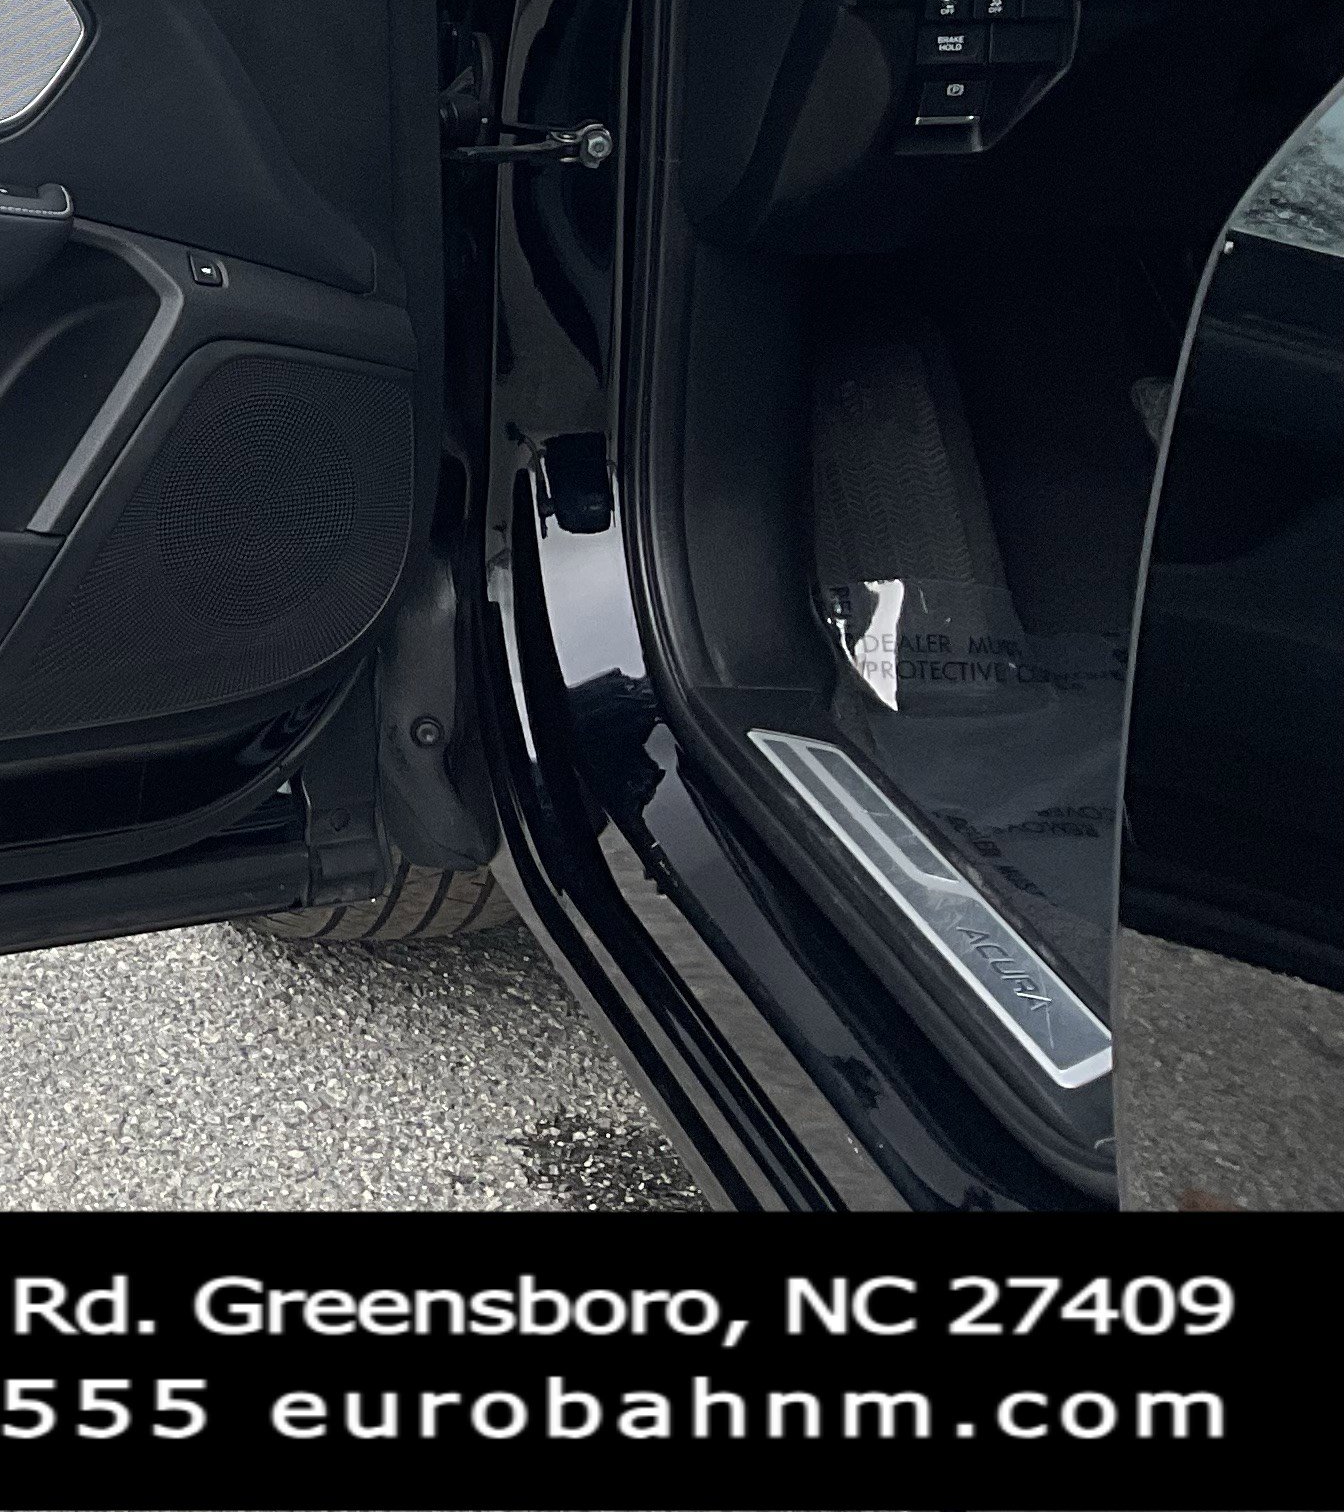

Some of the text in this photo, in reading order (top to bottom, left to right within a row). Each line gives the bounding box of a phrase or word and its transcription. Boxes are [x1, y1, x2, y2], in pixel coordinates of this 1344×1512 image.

[940, 7, 955, 15] OFF
[937, 35, 965, 44] BRAKE
[938, 43, 963, 52] HOLD
[862, 634, 952, 654] DEALER
[864, 660, 1011, 683] PROTECTIVE
[955, 926, 1053, 1010] ACURA
